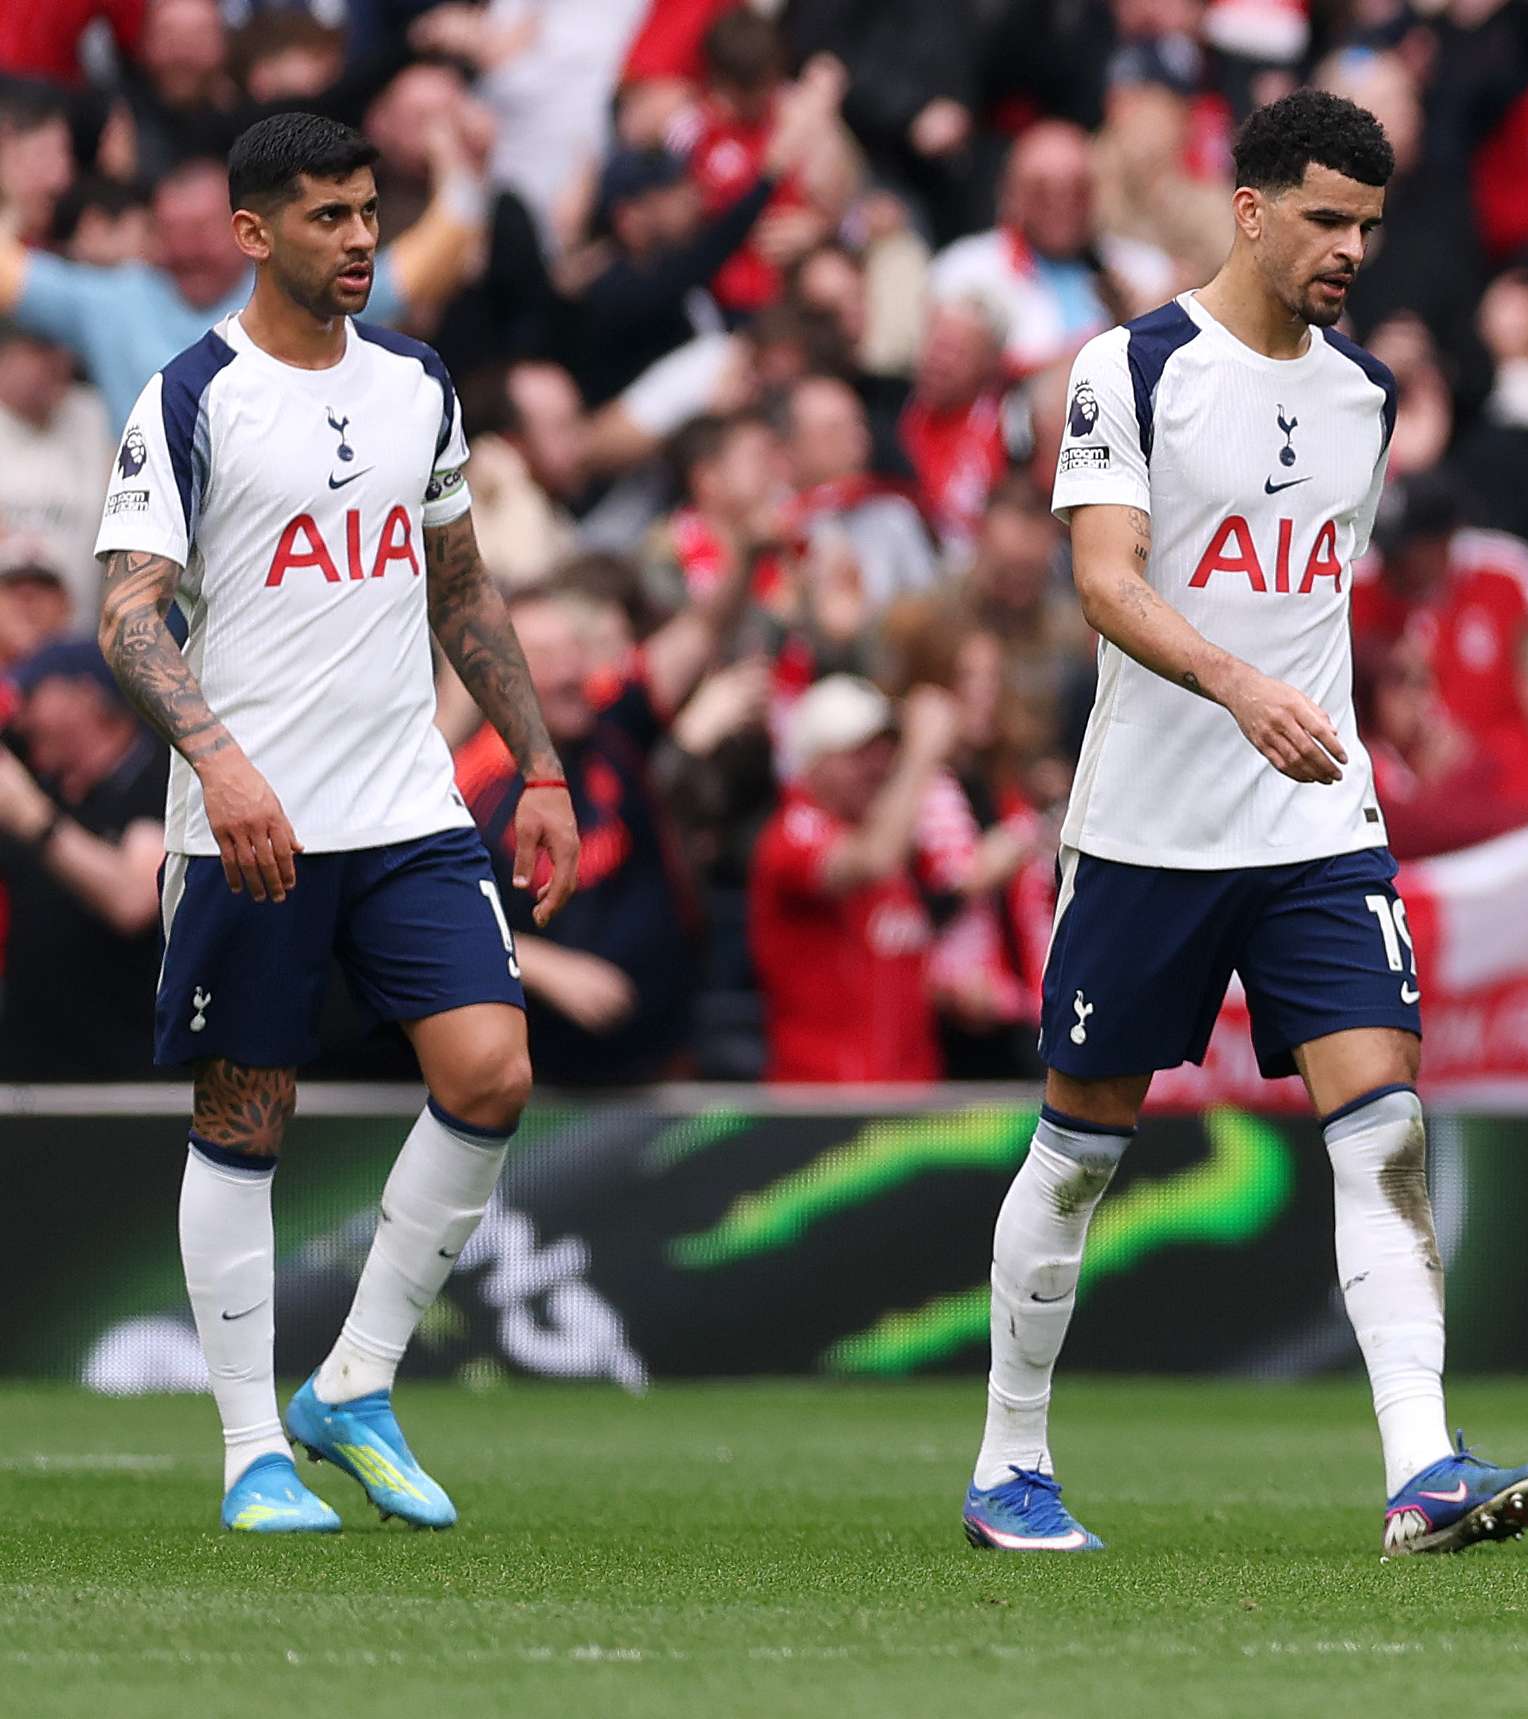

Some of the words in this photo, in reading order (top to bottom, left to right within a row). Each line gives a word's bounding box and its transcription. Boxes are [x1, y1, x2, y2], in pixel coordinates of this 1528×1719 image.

[1069, 448, 1104, 460] room
[1069, 459, 1110, 469] racism
[264, 504, 420, 587] AIA
[1188, 515, 1341, 593] AIA
